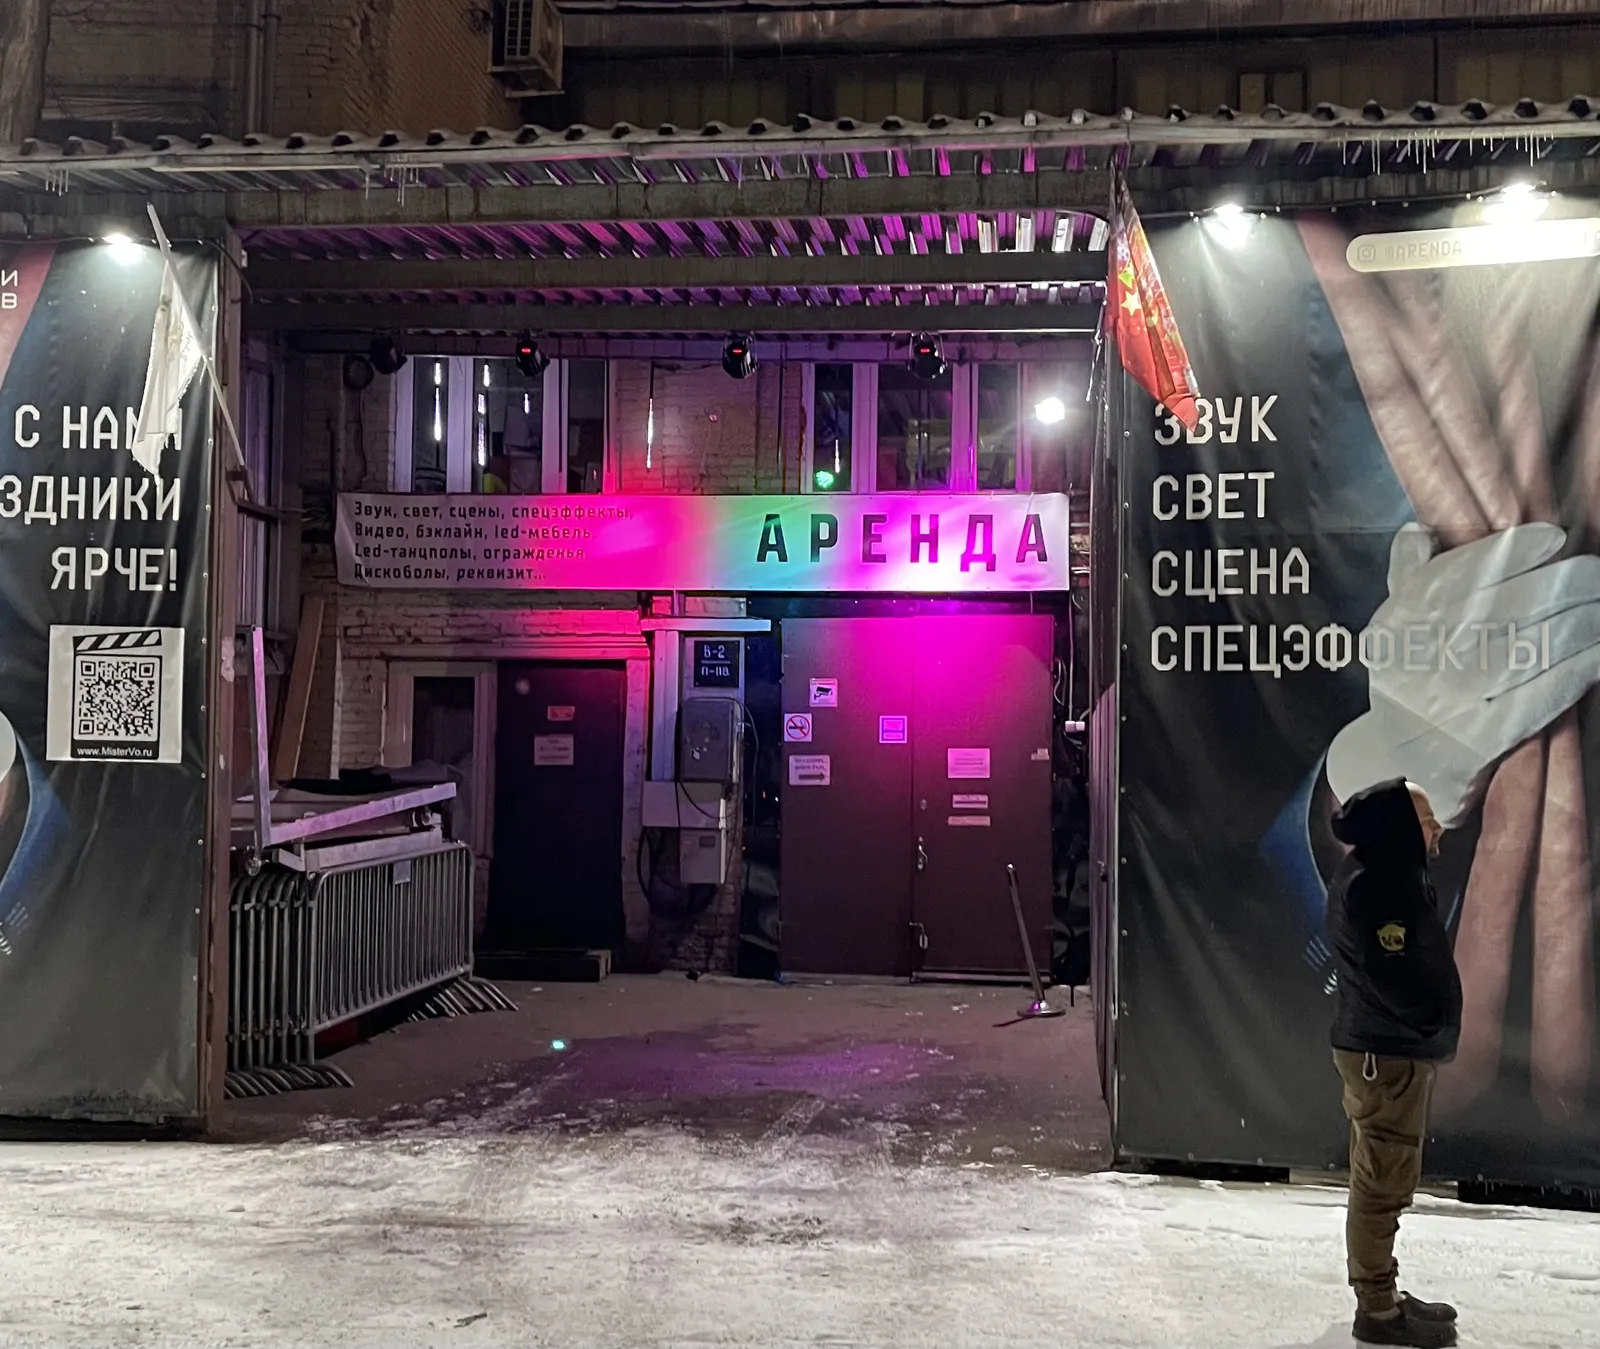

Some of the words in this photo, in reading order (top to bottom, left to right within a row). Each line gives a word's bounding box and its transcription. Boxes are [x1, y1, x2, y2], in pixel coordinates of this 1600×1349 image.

[15, 404, 40, 448] С
[62, 405, 182, 450] НА
[1153, 394, 1278, 446] ЗВУК
[0, 474, 181, 526] ЗДНИКИ
[354, 501, 397, 519] Звук,
[402, 505, 443, 519] свет,
[449, 506, 505, 520] сцены,
[511, 505, 635, 520] спецэффекты,
[1151, 471, 1275, 521] СВЕТ
[355, 522, 409, 539] Видео,
[416, 524, 488, 540] бэклайн,
[355, 543, 477, 560] Led-танцполы,
[756, 513, 1048, 572] АРЕНДА
[51, 546, 178, 591] ЯРЧЕ!
[354, 563, 450, 580] Дискоболы,
[456, 568, 546, 581] реквизит...
[1151, 547, 1311, 603] СЦЕНА
[1151, 622, 1551, 679] СПЕЦЭФФЕКТЫ
[76, 746, 153, 757] www.MisterVo.ru
